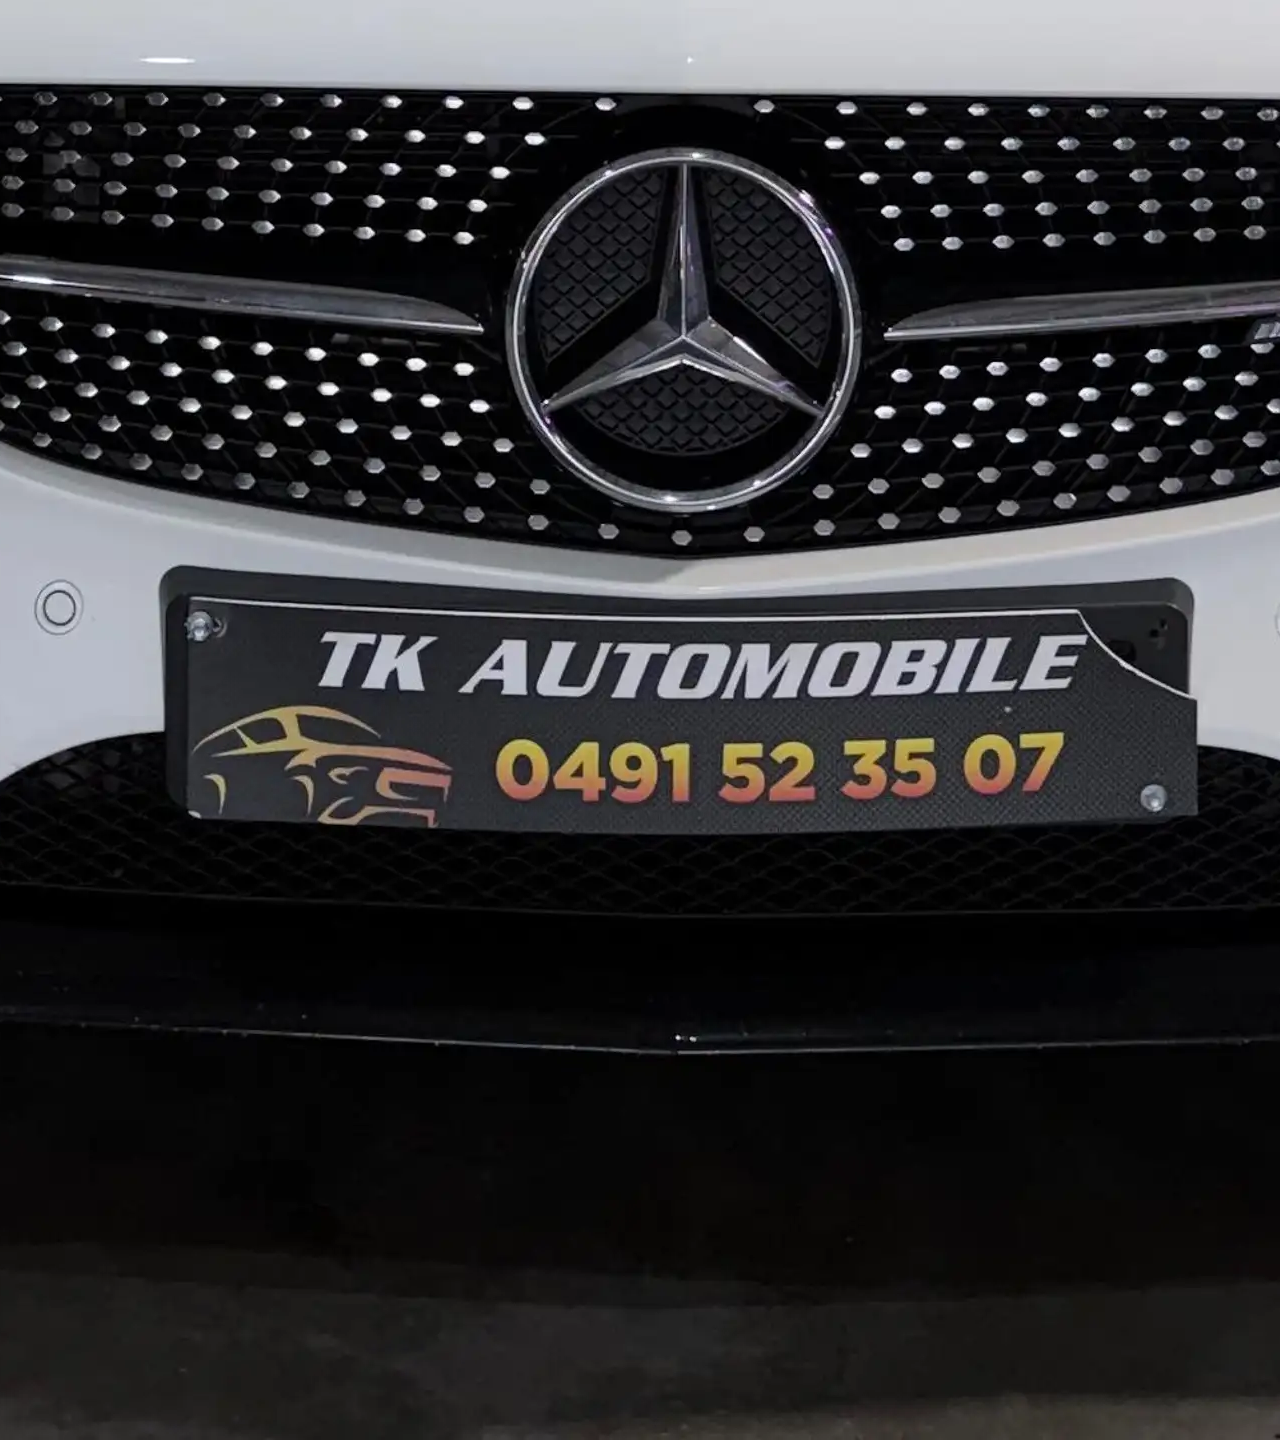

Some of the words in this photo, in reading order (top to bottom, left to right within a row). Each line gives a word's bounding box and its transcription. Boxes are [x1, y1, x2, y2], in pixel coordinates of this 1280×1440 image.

[318, 631, 438, 692] TK
[457, 634, 1089, 700] AUTOMOBILE
[496, 739, 691, 803] 0491
[719, 741, 816, 803] 52
[841, 737, 937, 799] 35
[963, 732, 1064, 794] 07
